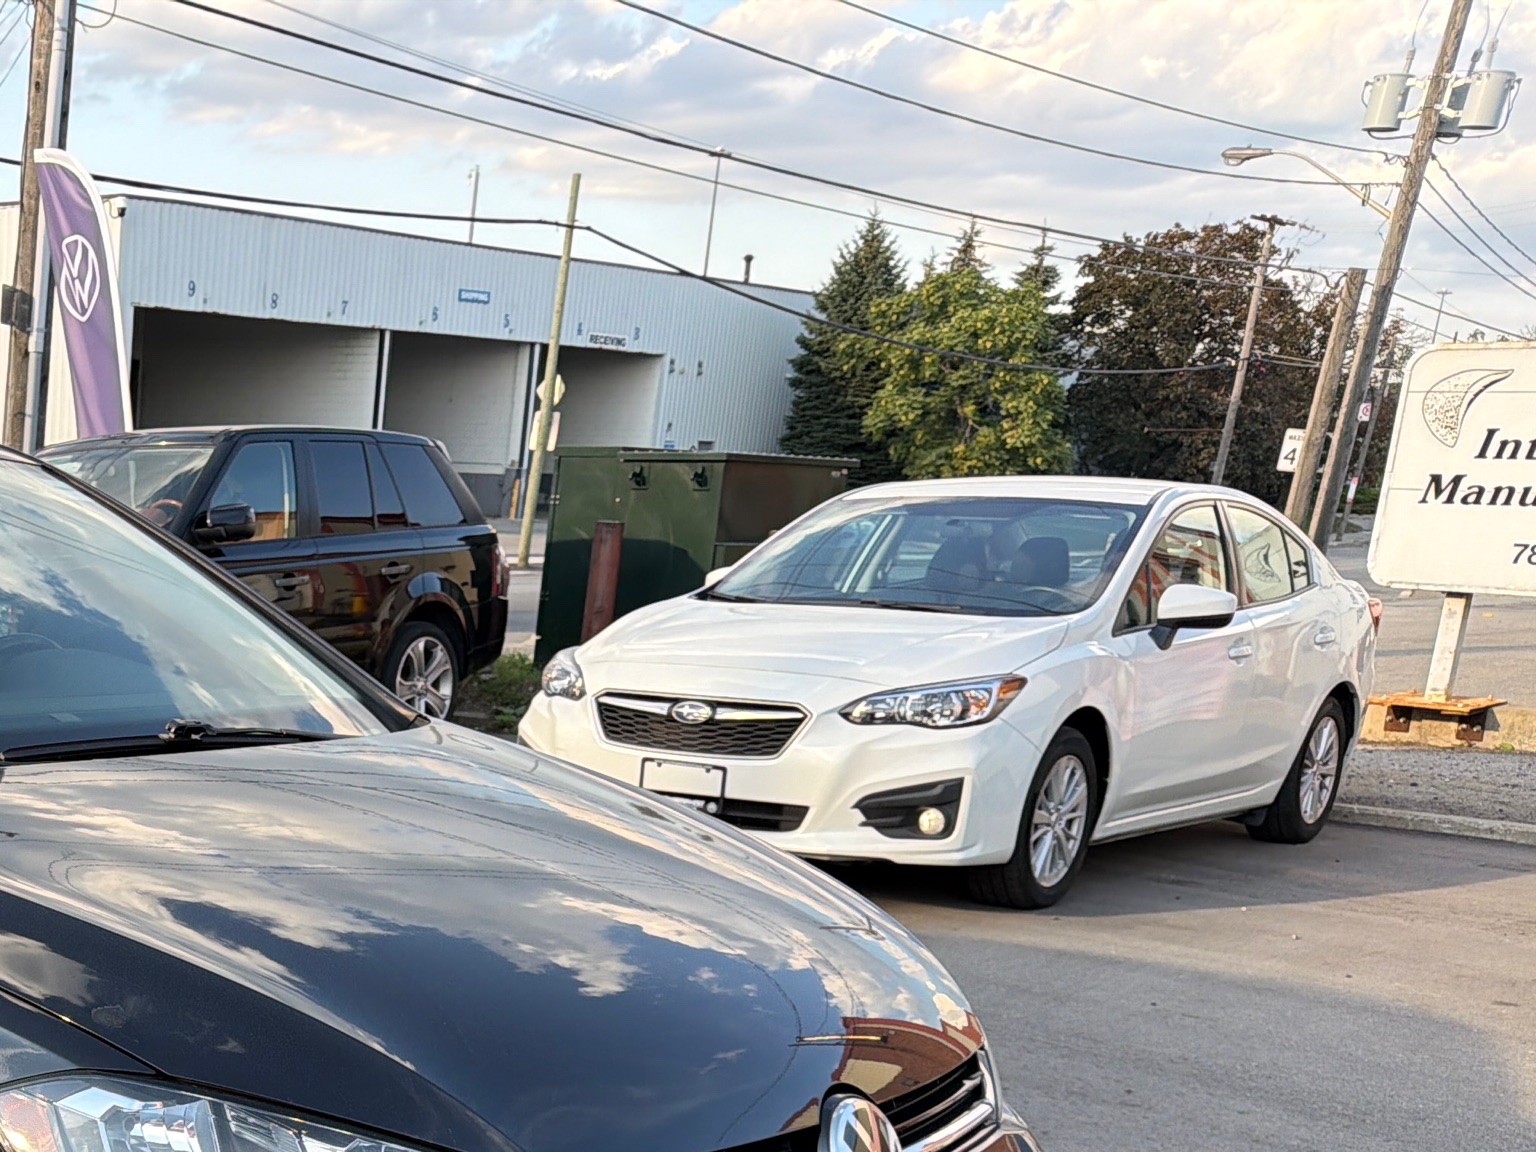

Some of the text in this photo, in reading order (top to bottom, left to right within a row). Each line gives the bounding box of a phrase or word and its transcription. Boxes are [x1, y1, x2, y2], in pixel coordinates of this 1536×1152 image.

[187, 280, 196, 297] 9
[270, 293, 279, 309] 8
[341, 300, 349, 315] 7
[432, 306, 439, 322] 6
[504, 313, 510, 328] 5
[589, 334, 627, 347] RECEIVING
[1474, 428, 1536, 460] Int
[1418, 474, 1536, 507] Manu
